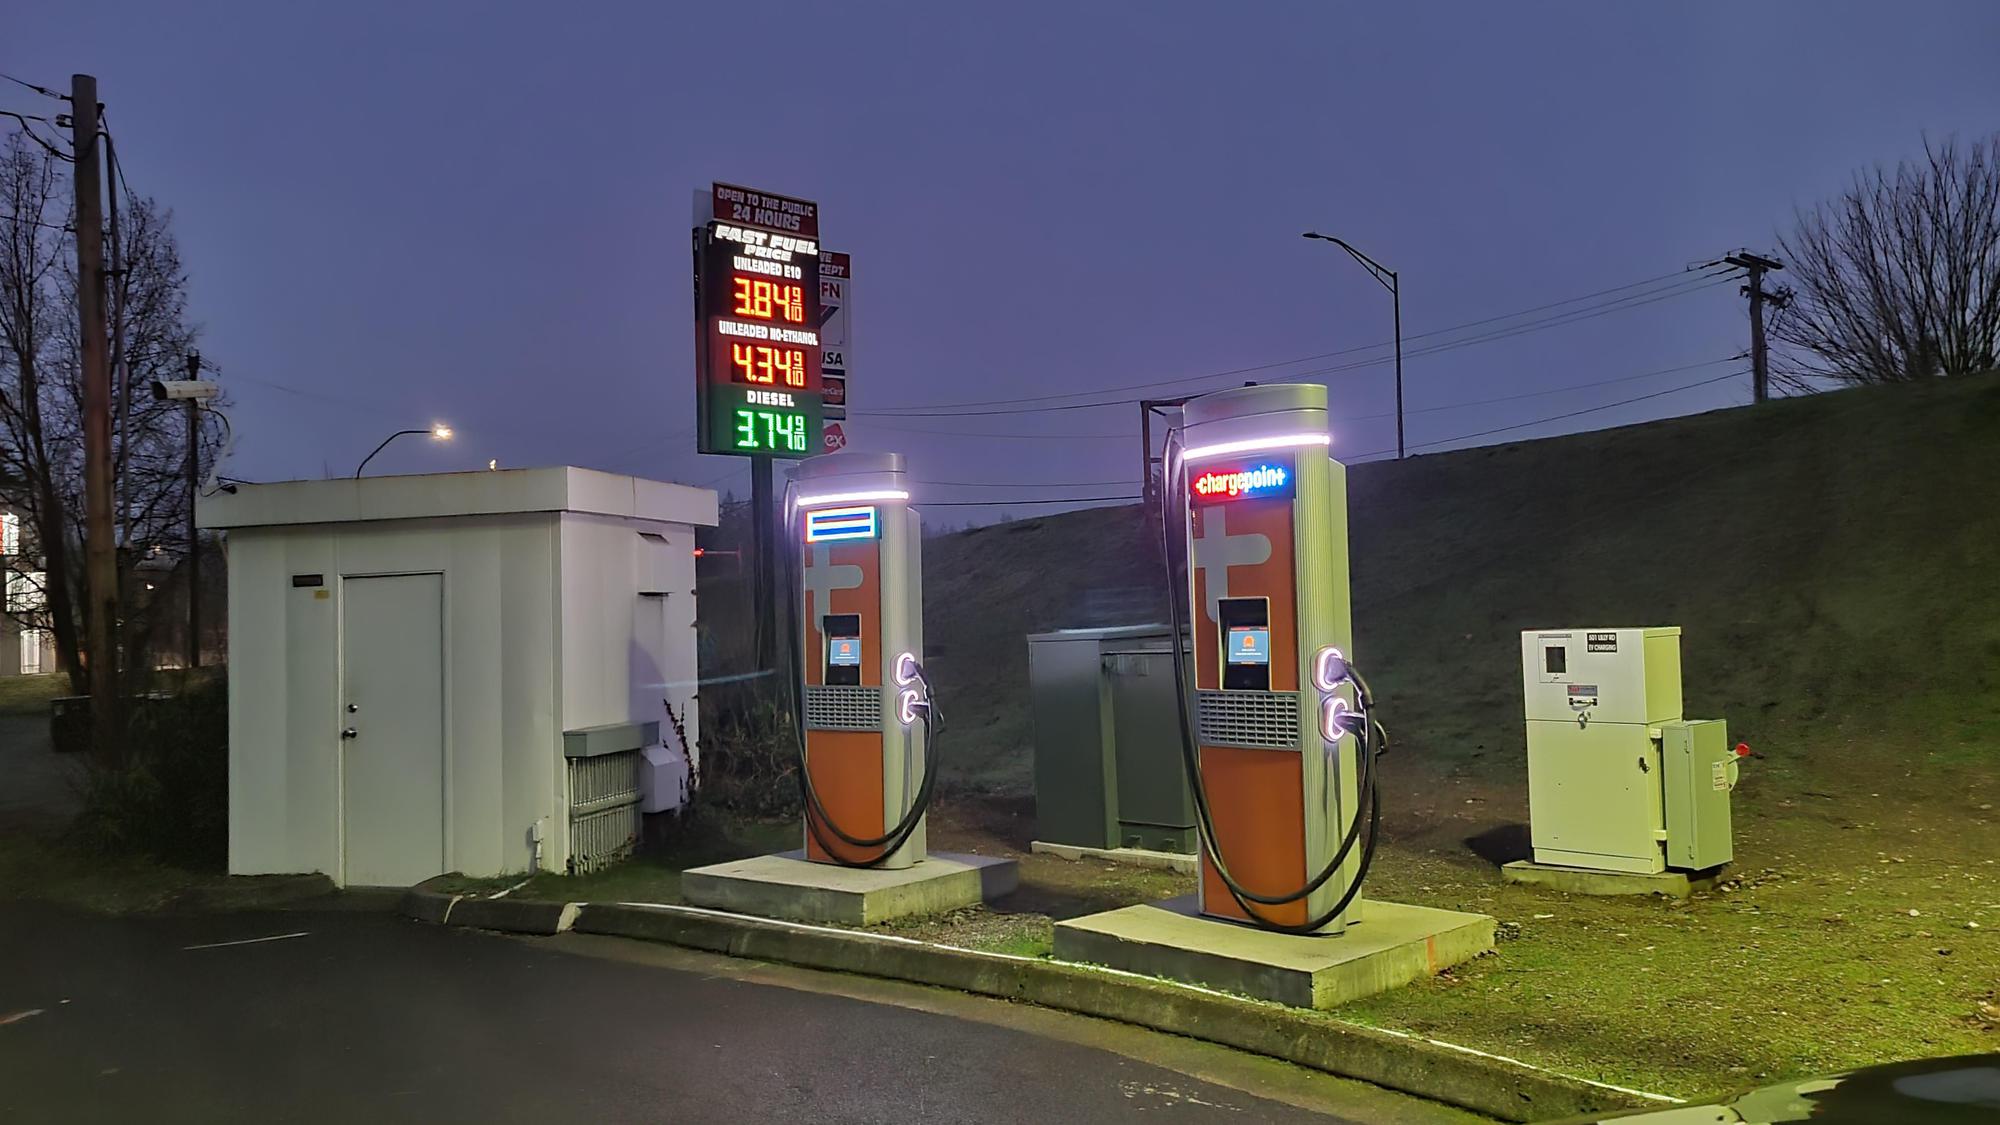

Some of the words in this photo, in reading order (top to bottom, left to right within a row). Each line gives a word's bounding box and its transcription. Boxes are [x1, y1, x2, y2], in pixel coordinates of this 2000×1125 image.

[718, 188, 744, 203] OPEN
[747, 193, 760, 207] TO
[762, 197, 780, 211] THE
[782, 201, 814, 217] PUBLIC
[732, 204, 751, 222] 24
[754, 209, 801, 231] HOURS
[715, 225, 768, 247] FAST
[769, 234, 818, 256] FUEL
[743, 244, 792, 262] PRICE
[733, 256, 782, 276] UNLEADED
[783, 264, 802, 280] E10
[733, 277, 791, 321] 3.84
[821, 281, 841, 299] FN
[719, 320, 767, 339] UNLEADED
[769, 328, 818, 345] NO-ETHANOL
[733, 344, 792, 386] 4.34
[746, 390, 795, 407] DIESEL
[737, 410, 793, 450] 3.74
[1195, 464, 1287, 496] chargepoint
